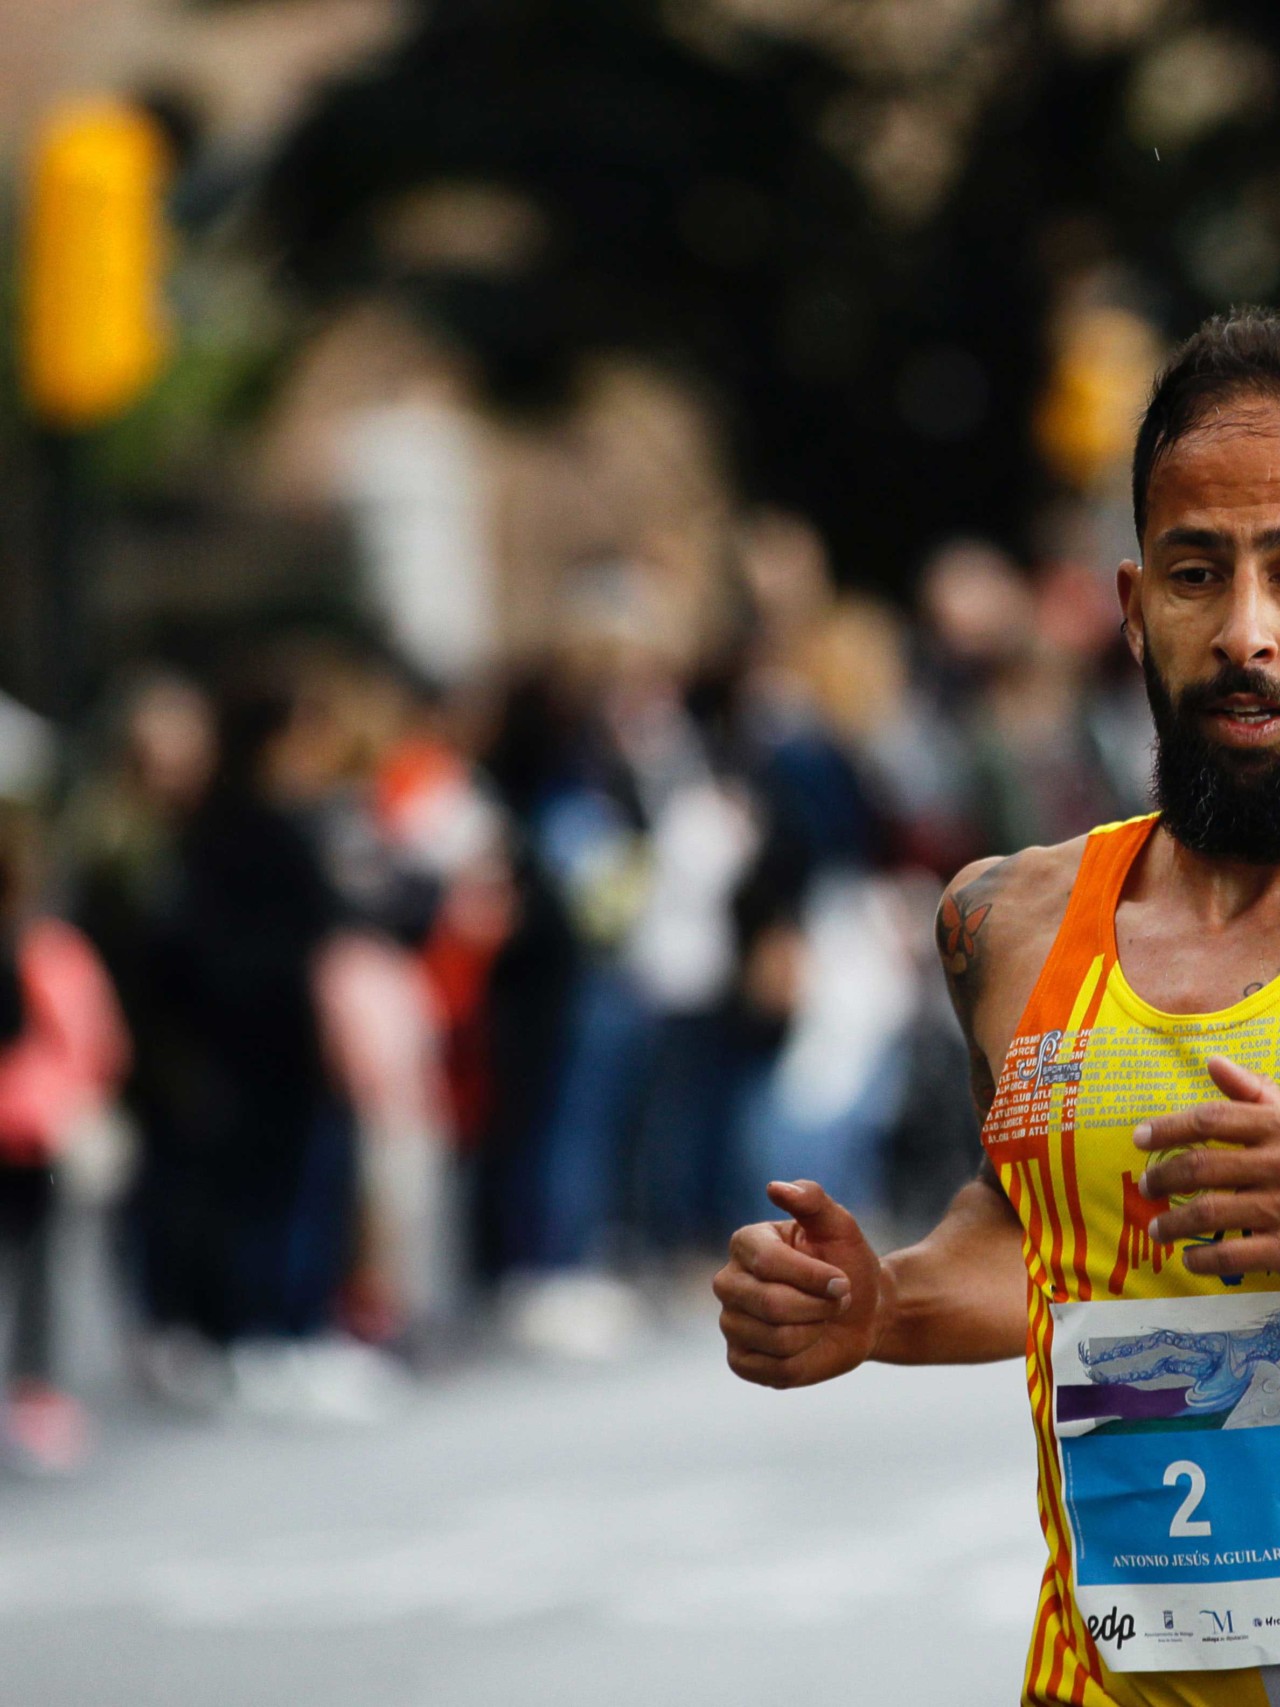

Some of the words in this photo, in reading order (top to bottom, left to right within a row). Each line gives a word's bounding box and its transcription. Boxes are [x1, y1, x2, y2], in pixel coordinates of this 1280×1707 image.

[1163, 1460, 1212, 1537] 2
[1113, 1554, 1169, 1568] ANTONIO
[1171, 1550, 1210, 1567] JESÚS
[1087, 1605, 1136, 1650] edp
